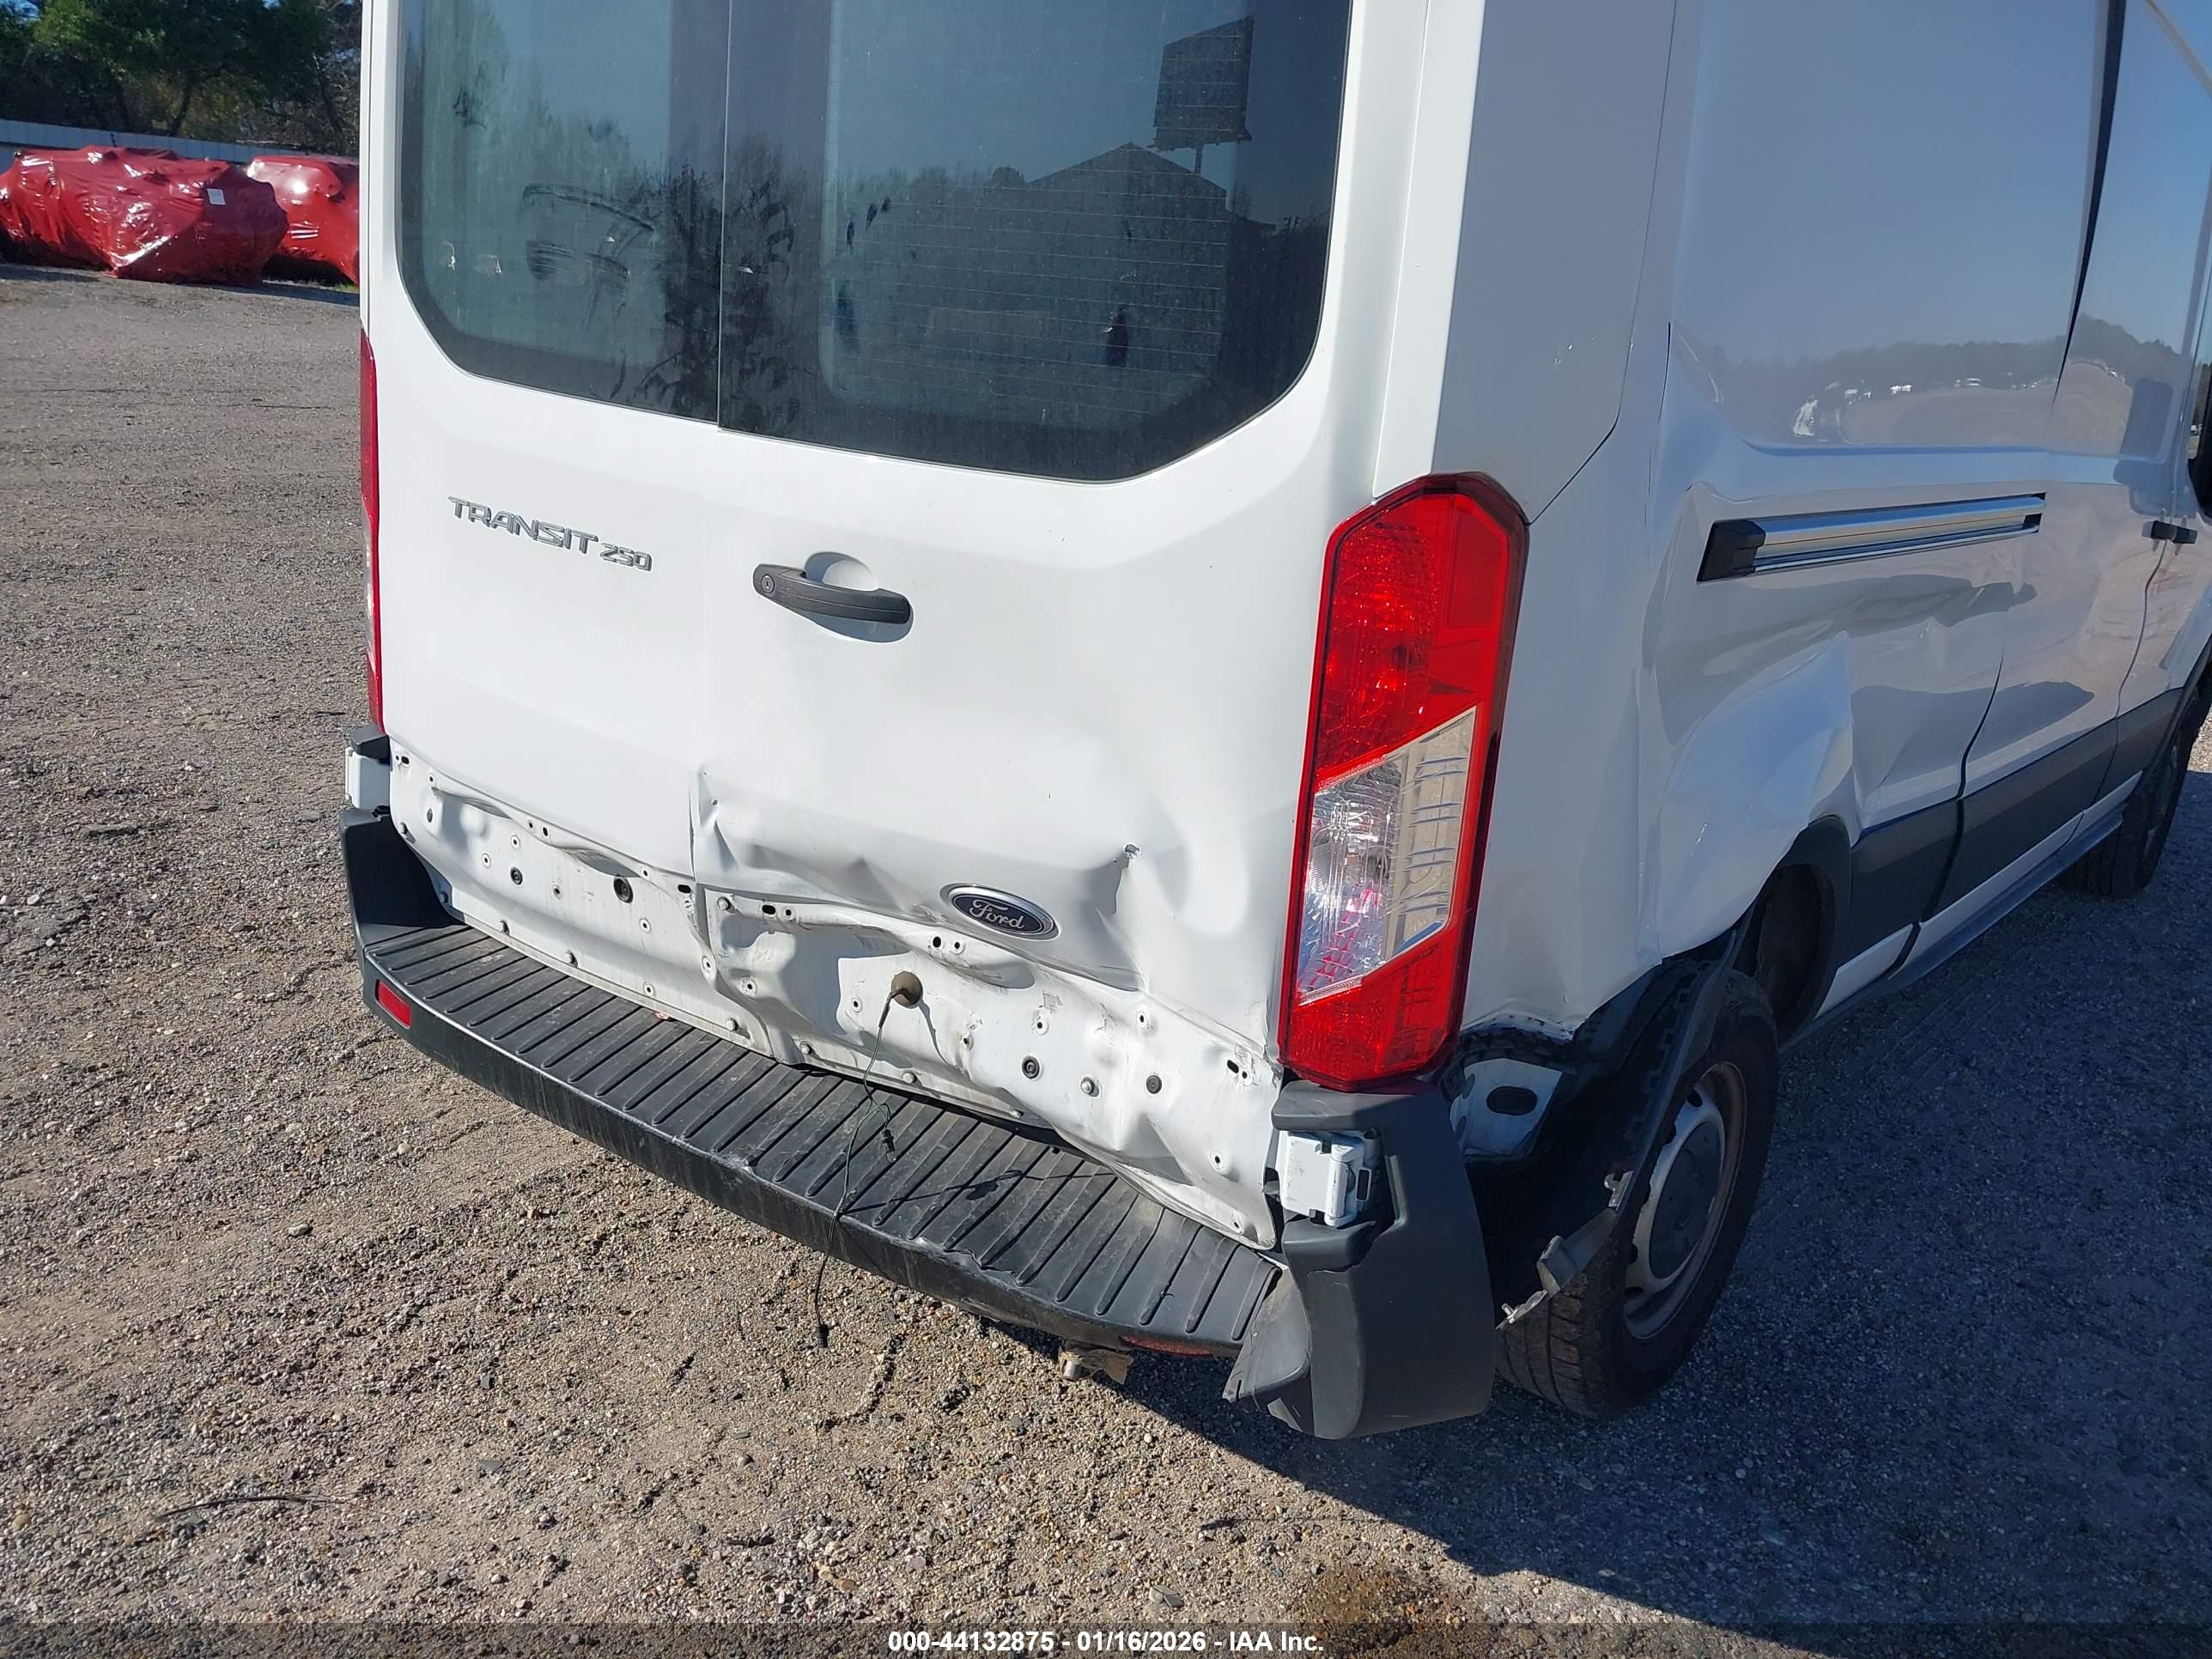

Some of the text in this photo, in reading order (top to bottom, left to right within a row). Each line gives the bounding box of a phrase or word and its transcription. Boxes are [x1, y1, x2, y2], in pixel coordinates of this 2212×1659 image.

[448, 495, 653, 572] TRANSIT 250
[969, 899, 1025, 929] Ford
